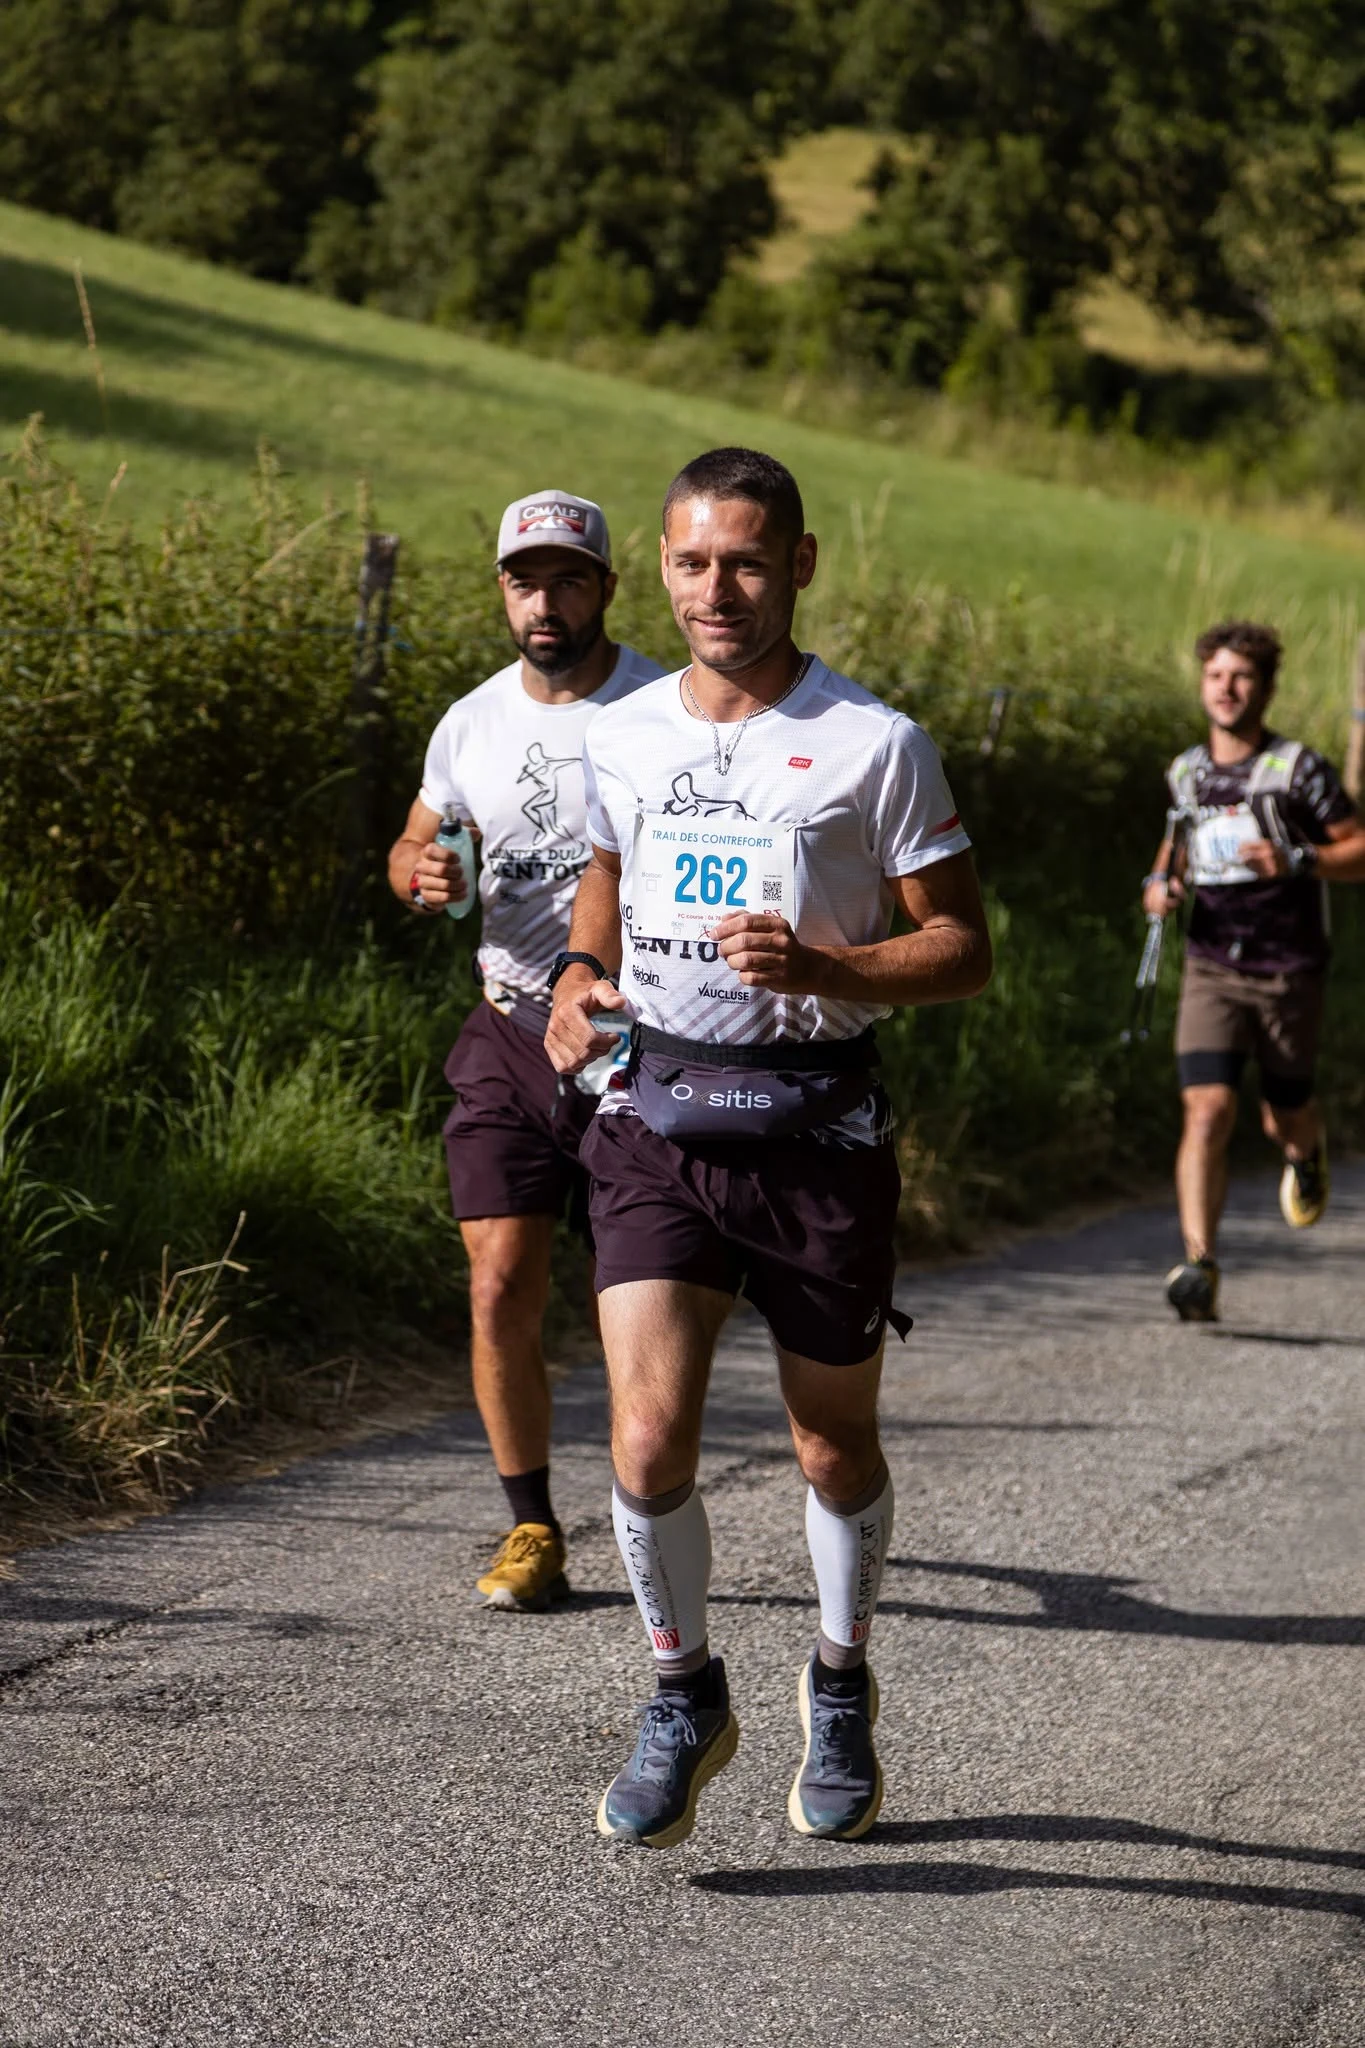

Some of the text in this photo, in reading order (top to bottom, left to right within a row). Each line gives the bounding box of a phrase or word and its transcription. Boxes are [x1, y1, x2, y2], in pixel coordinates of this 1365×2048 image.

[652, 830, 773, 848] TRAIL DES CONTREFORTS
[674, 853, 748, 907] 262
[698, 981, 750, 1001] VAUCLUSE
